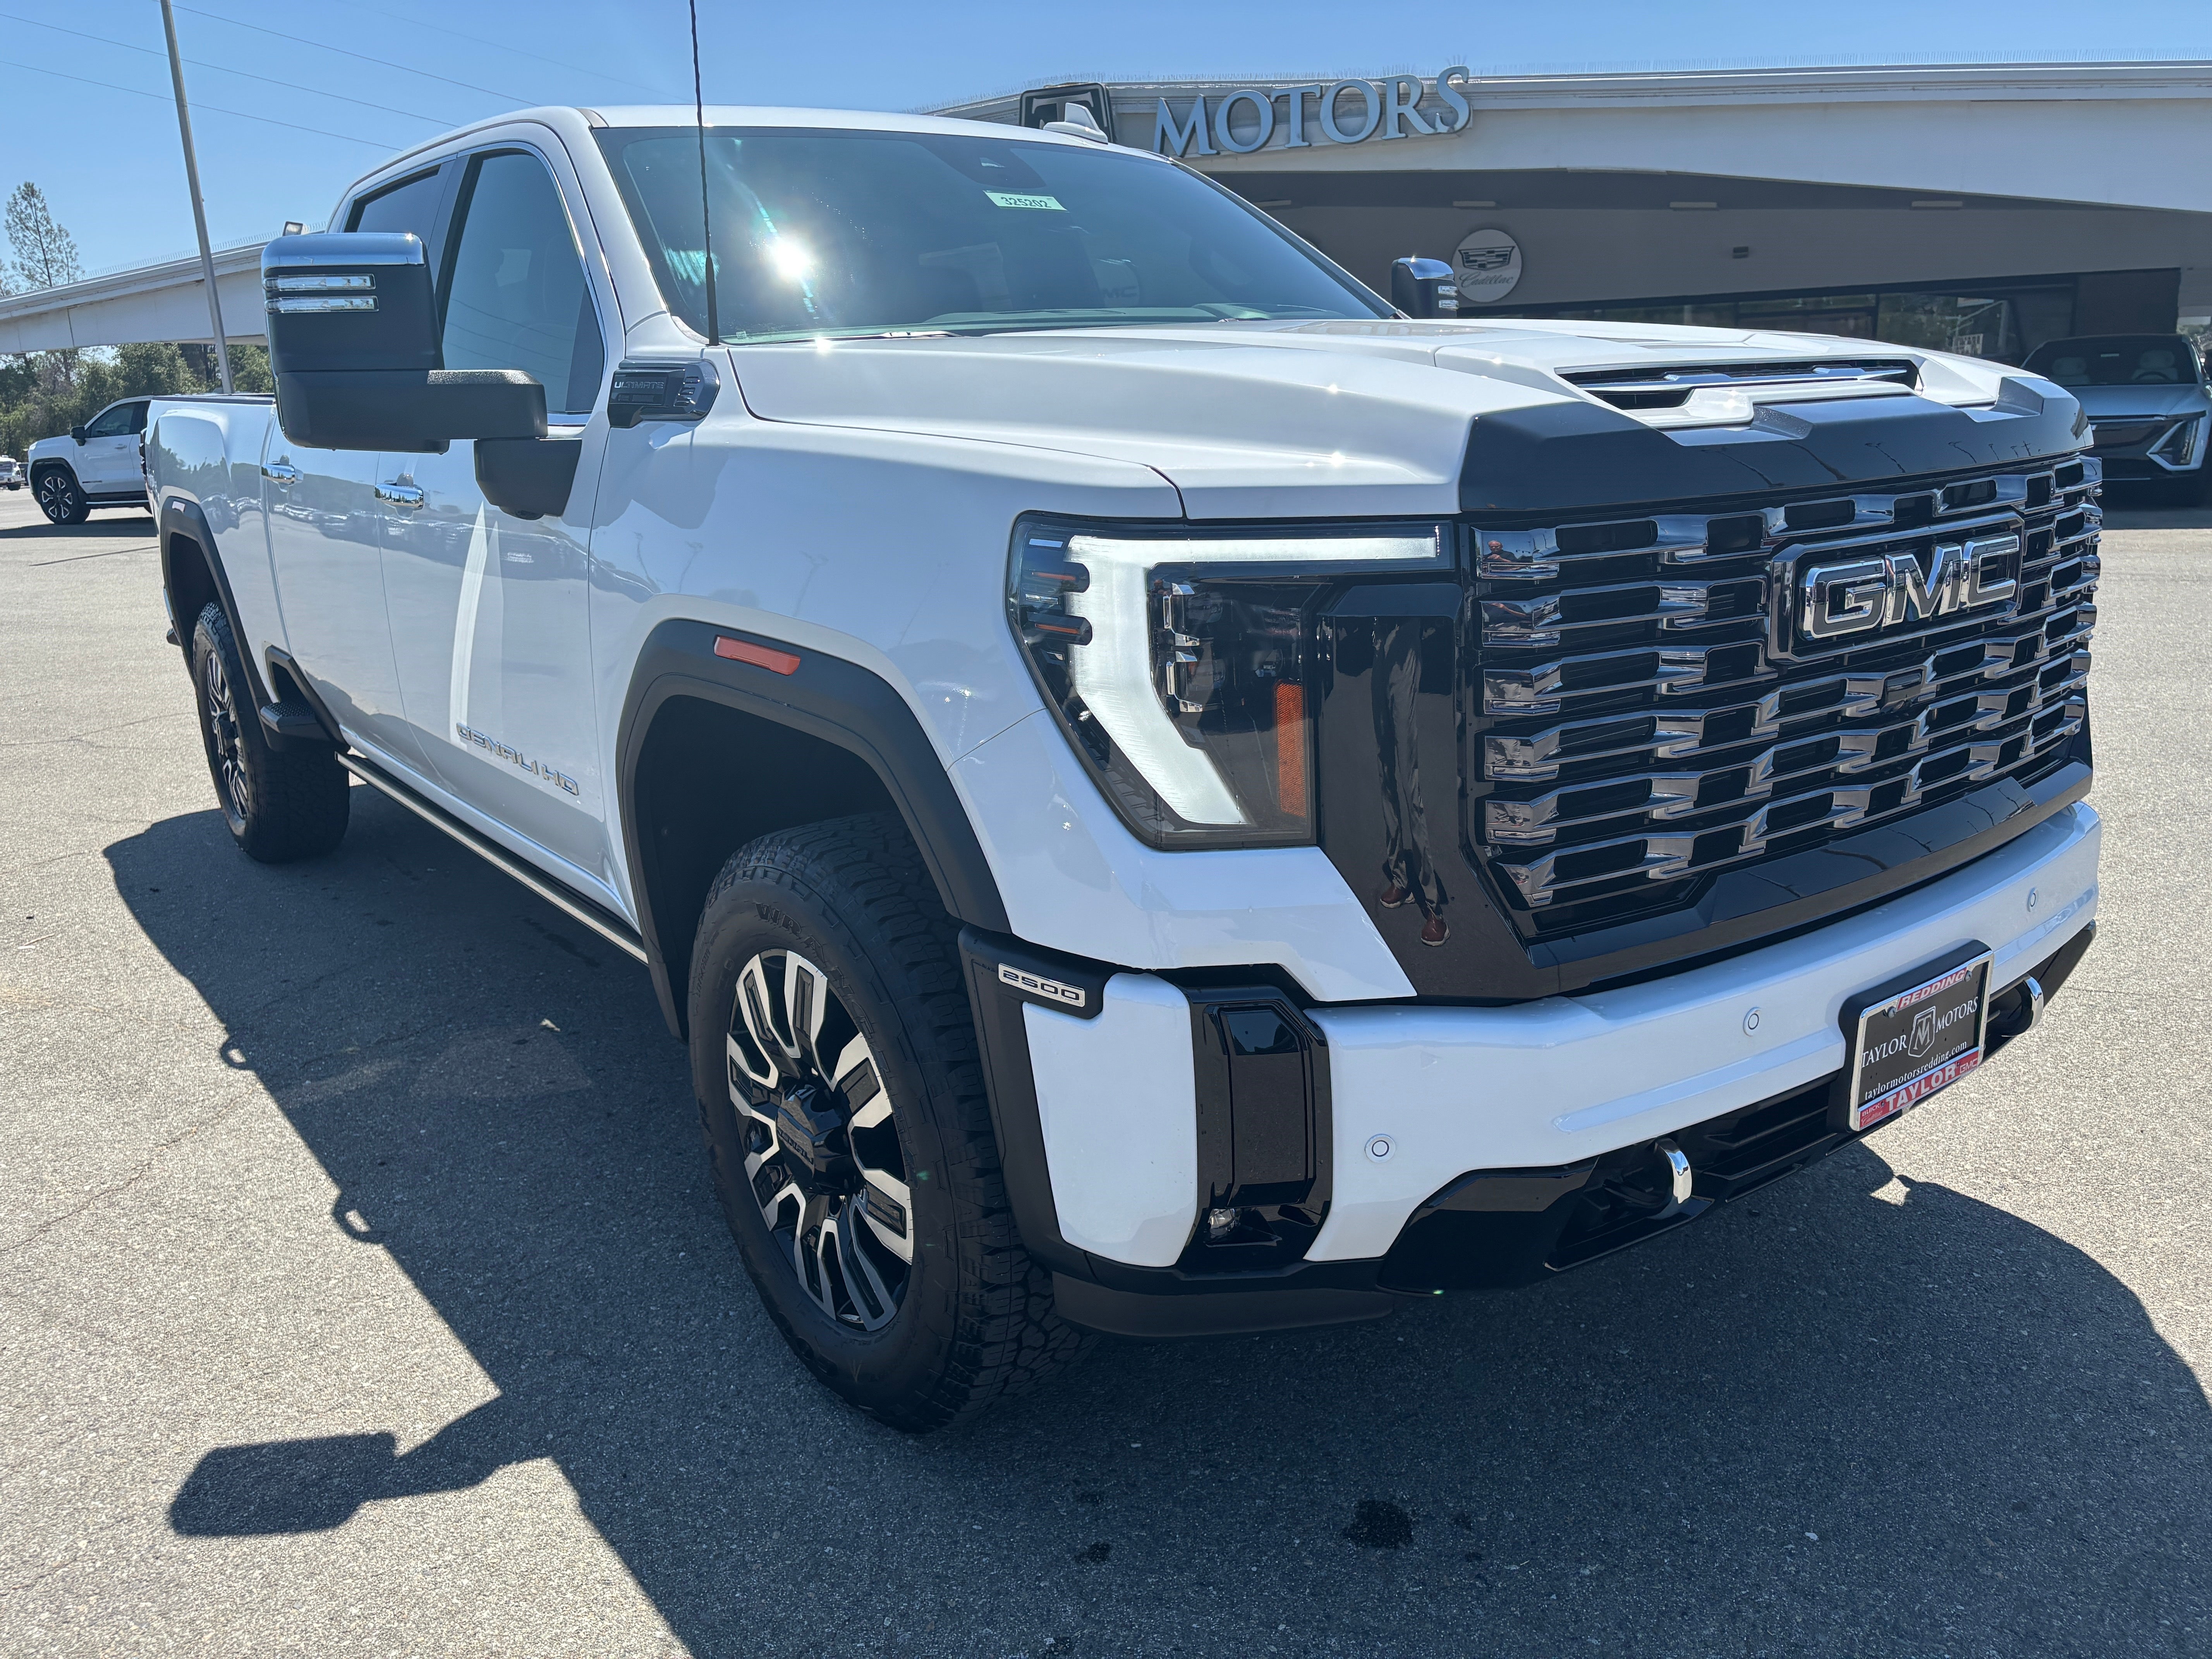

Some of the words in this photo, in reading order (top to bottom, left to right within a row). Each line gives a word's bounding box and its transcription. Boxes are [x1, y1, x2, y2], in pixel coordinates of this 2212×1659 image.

[1153, 65, 1471, 157] MOTORS
[1000, 196, 1052, 208] 325202
[614, 381, 664, 389] ULTIMATE
[1799, 531, 2019, 641] GMC
[456, 722, 539, 775] DENALI
[541, 764, 579, 796] HD
[1003, 970, 1080, 1001] 2500
[1900, 969, 1965, 1008] REDDING
[1862, 1034, 1907, 1068] TAYLOR
[1936, 996, 1978, 1033] MOTORS
[1865, 1041, 1967, 1101] taylormotorsredding.com
[1886, 1063, 1956, 1111] TAYLOR
[1959, 1058, 1978, 1074] GMC
